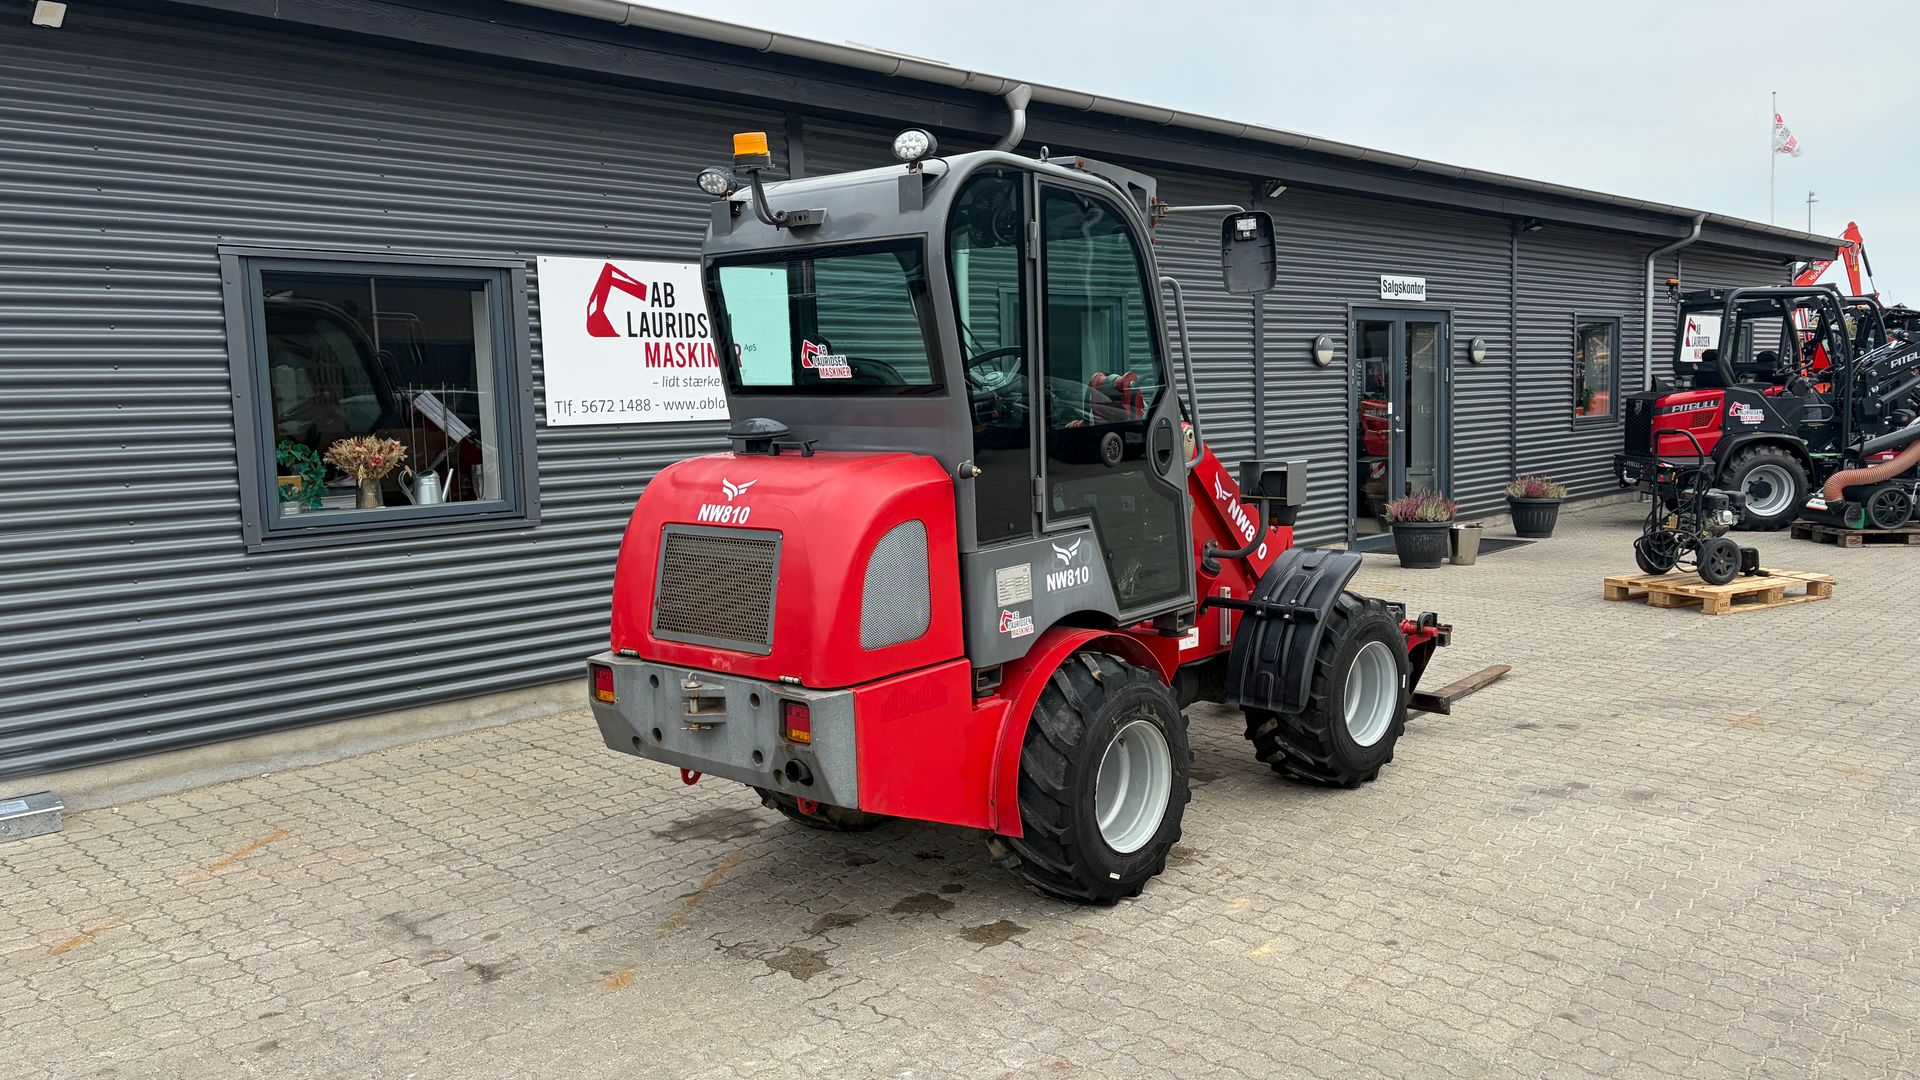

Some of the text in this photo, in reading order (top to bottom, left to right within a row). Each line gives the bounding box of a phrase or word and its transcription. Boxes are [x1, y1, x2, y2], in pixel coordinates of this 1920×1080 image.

[650, 281, 676, 308] AB
[1382, 279, 1425, 297] Salgskontor
[626, 311, 713, 339] LAURIDS
[644, 341, 743, 369] MASKINR
[662, 375, 681, 388] lidt
[682, 375, 724, 388] stærke
[818, 367, 851, 378] MASKINER
[554, 400, 577, 417] Tlf.
[581, 399, 615, 414] 5672
[618, 398, 651, 413] 1488
[663, 396, 729, 411] www.abla
[1671, 400, 1717, 413] PITBULL
[696, 503, 751, 525] NW810
[1227, 498, 1268, 560] NW80
[1046, 565, 1090, 592] NW810
